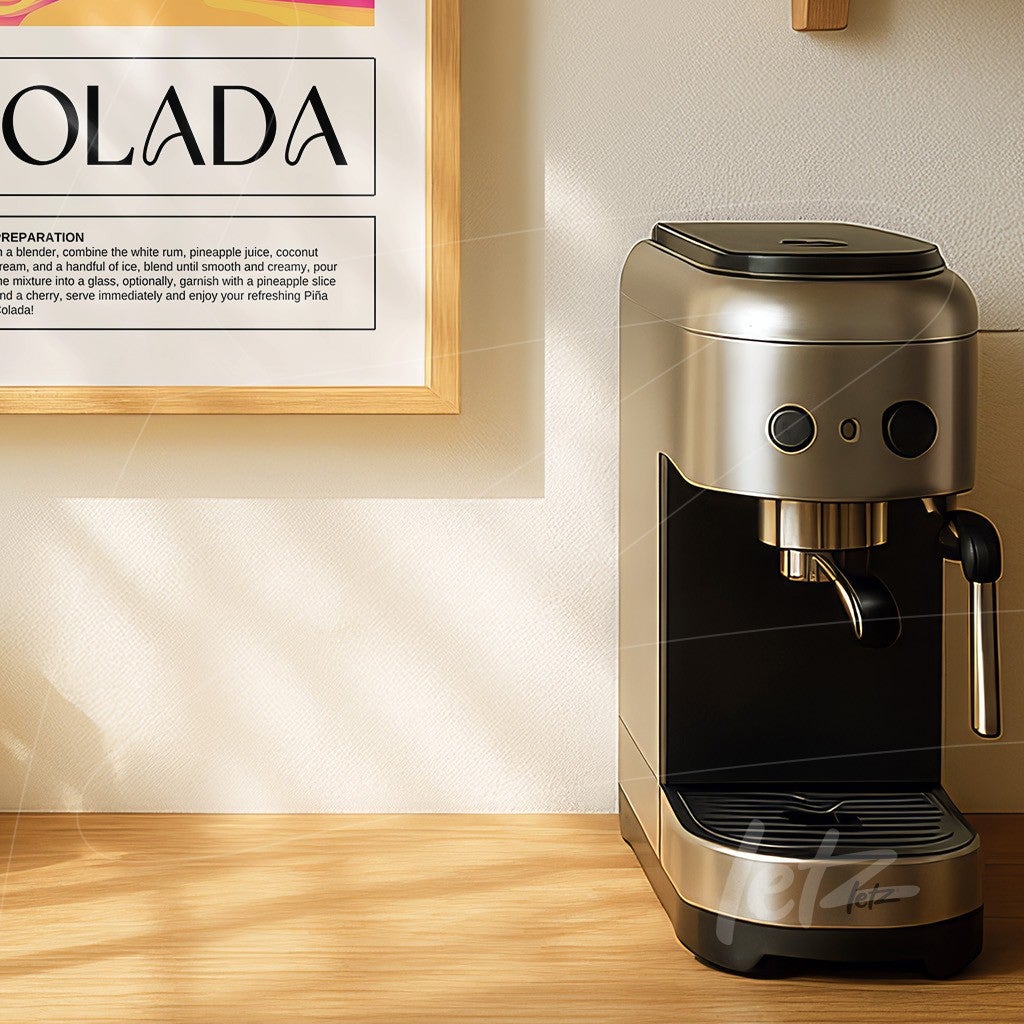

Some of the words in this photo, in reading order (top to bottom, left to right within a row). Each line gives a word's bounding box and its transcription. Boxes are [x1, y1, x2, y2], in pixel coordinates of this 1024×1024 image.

[5, 248, 14, 258] a
[15, 246, 60, 259] blender,
[62, 246, 109, 258] combine
[110, 246, 129, 258] the
[130, 246, 160, 258] white
[162, 248, 187, 259] rum,
[189, 246, 242, 260] pineapple
[243, 246, 273, 260] juice,
[275, 247, 319, 258] coconut
[32, 260, 53, 272] and
[55, 263, 64, 272] a
[65, 260, 106, 272] handful
[108, 260, 120, 272] of
[121, 260, 141, 273] ice,
[143, 260, 174, 272] blend
[176, 260, 199, 272] until
[201, 261, 241, 272] smooth
[243, 261, 265, 272] and
[267, 263, 310, 275] creamy,
[313, 263, 338, 275] pour
[12, 275, 53, 287] mixture
[55, 275, 75, 287] into
[77, 277, 86, 287] a
[87, 275, 119, 289] glass,
[122, 275, 177, 289] optionally,
[179, 275, 219, 289] garnish
[221, 275, 244, 287] with
[246, 277, 254, 287] a
[256, 275, 309, 289] pineapple
[311, 275, 337, 287] slice
[15, 292, 24, 301] a
[25, 289, 63, 304] cherry,
[65, 292, 96, 301] serve
[98, 289, 163, 304] immediately
[165, 290, 186, 301] and
[188, 289, 219, 304] enjoy
[220, 292, 245, 304] your
[247, 289, 301, 304] refreshing
[304, 290, 329, 301] Piña
